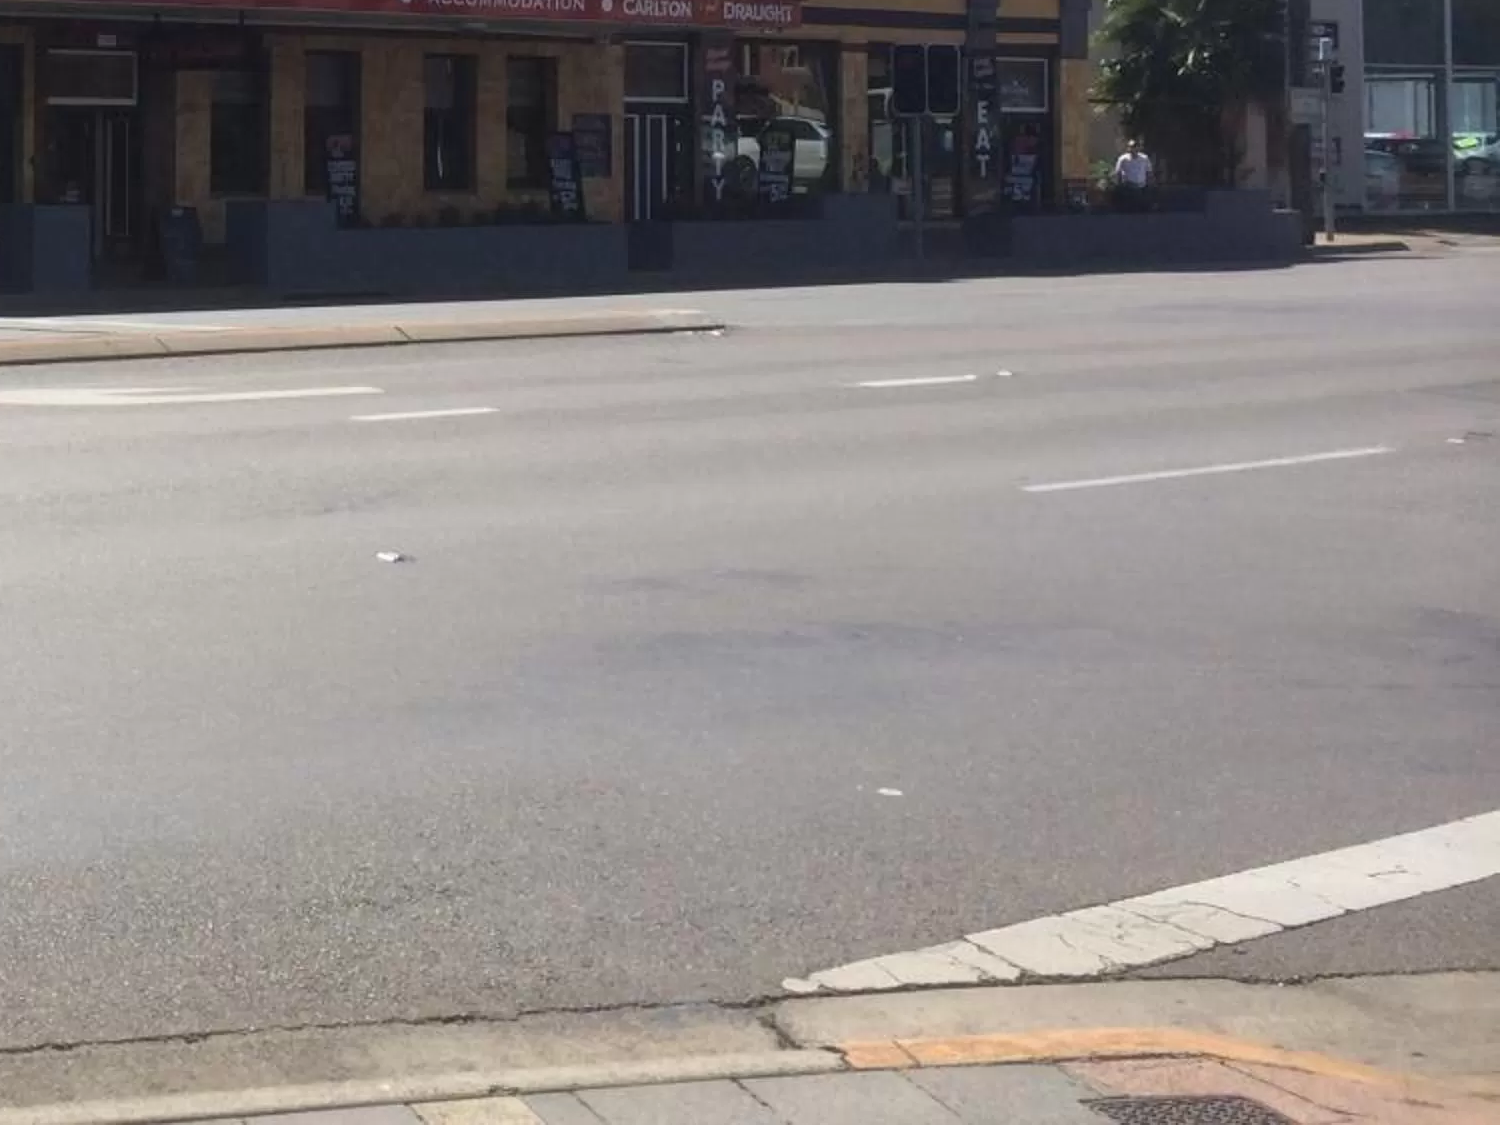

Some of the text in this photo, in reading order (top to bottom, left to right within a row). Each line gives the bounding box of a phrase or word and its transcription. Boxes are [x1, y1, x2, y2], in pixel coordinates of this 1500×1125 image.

[722, 0, 794, 24] DRAUGHT
[711, 78, 727, 201] PARTY
[975, 100, 991, 179] EAT
